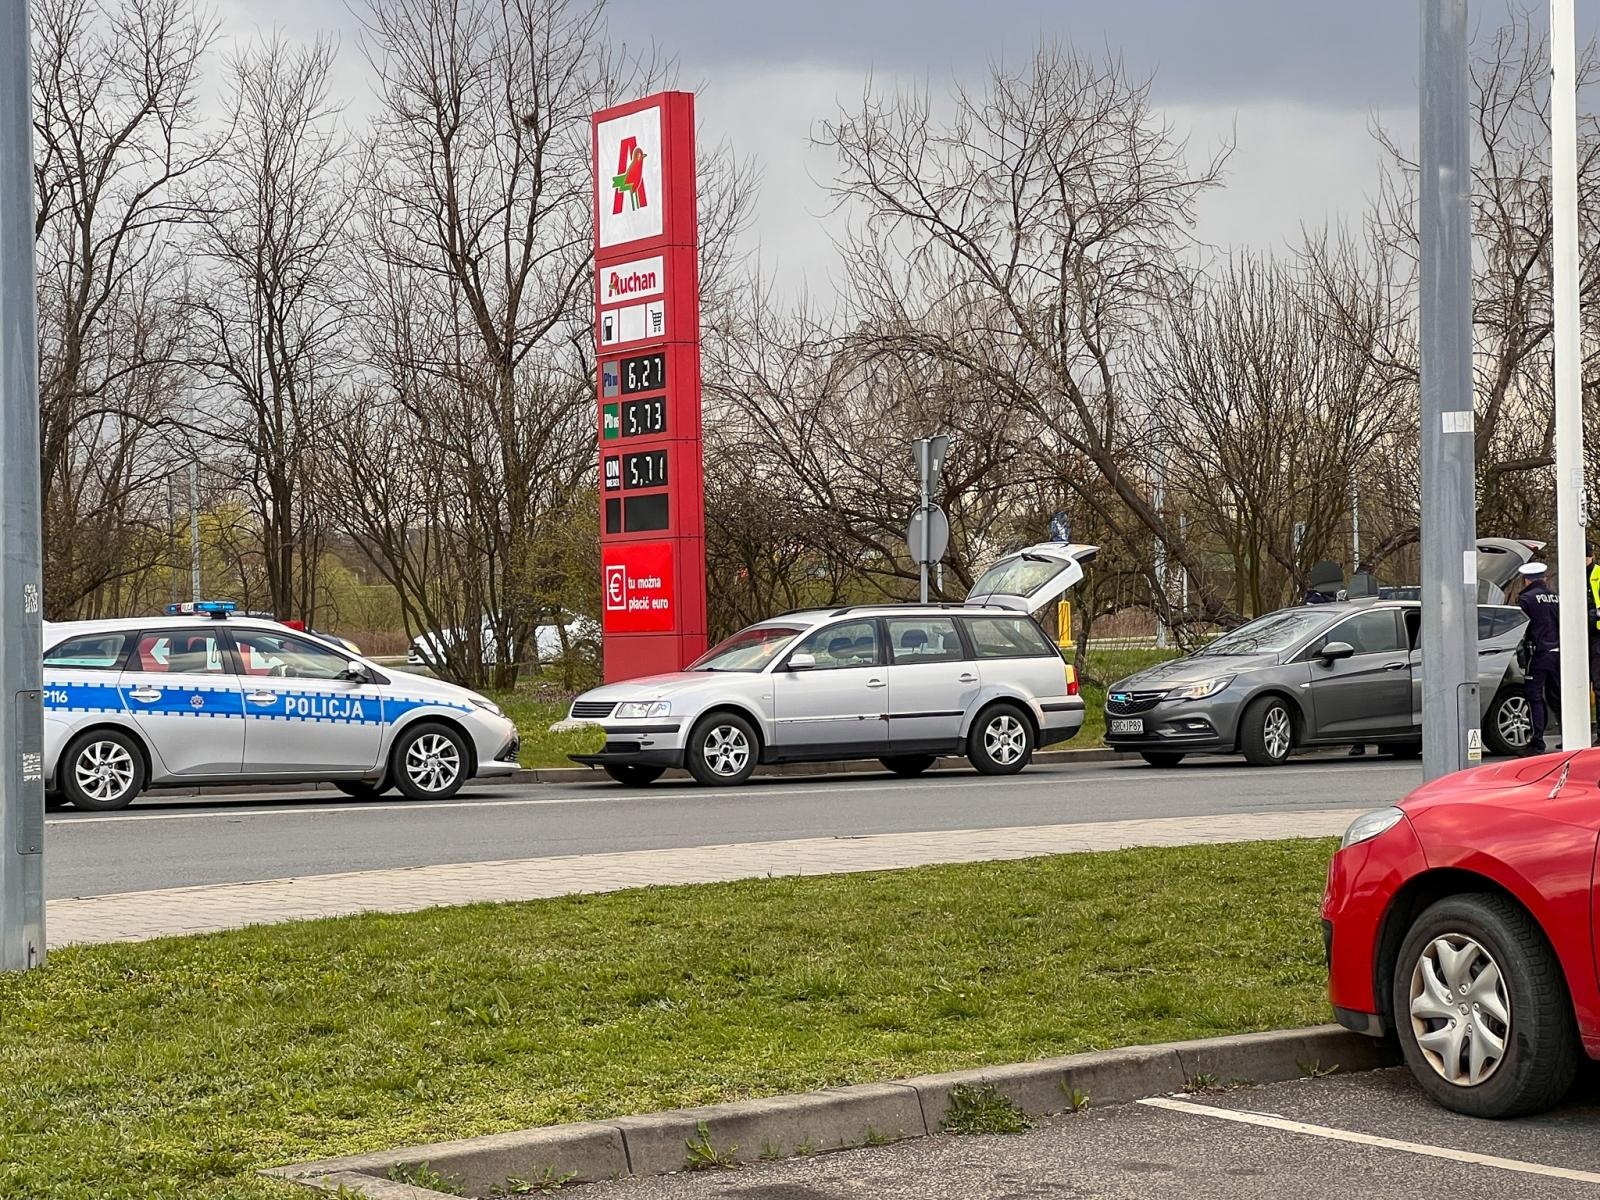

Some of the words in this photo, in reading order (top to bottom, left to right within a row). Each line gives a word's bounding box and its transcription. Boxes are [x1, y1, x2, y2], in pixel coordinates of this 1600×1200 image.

[609, 271, 656, 297] Auchan
[629, 358, 661, 390] 6,27
[629, 402, 661, 434] 5,73
[606, 460, 619, 477] ON
[630, 456, 663, 486] 5,71
[628, 576, 636, 590] tu
[651, 598, 669, 610] euro
[1536, 594, 1560, 603] POLICJ
[285, 696, 364, 719] POLICJA
